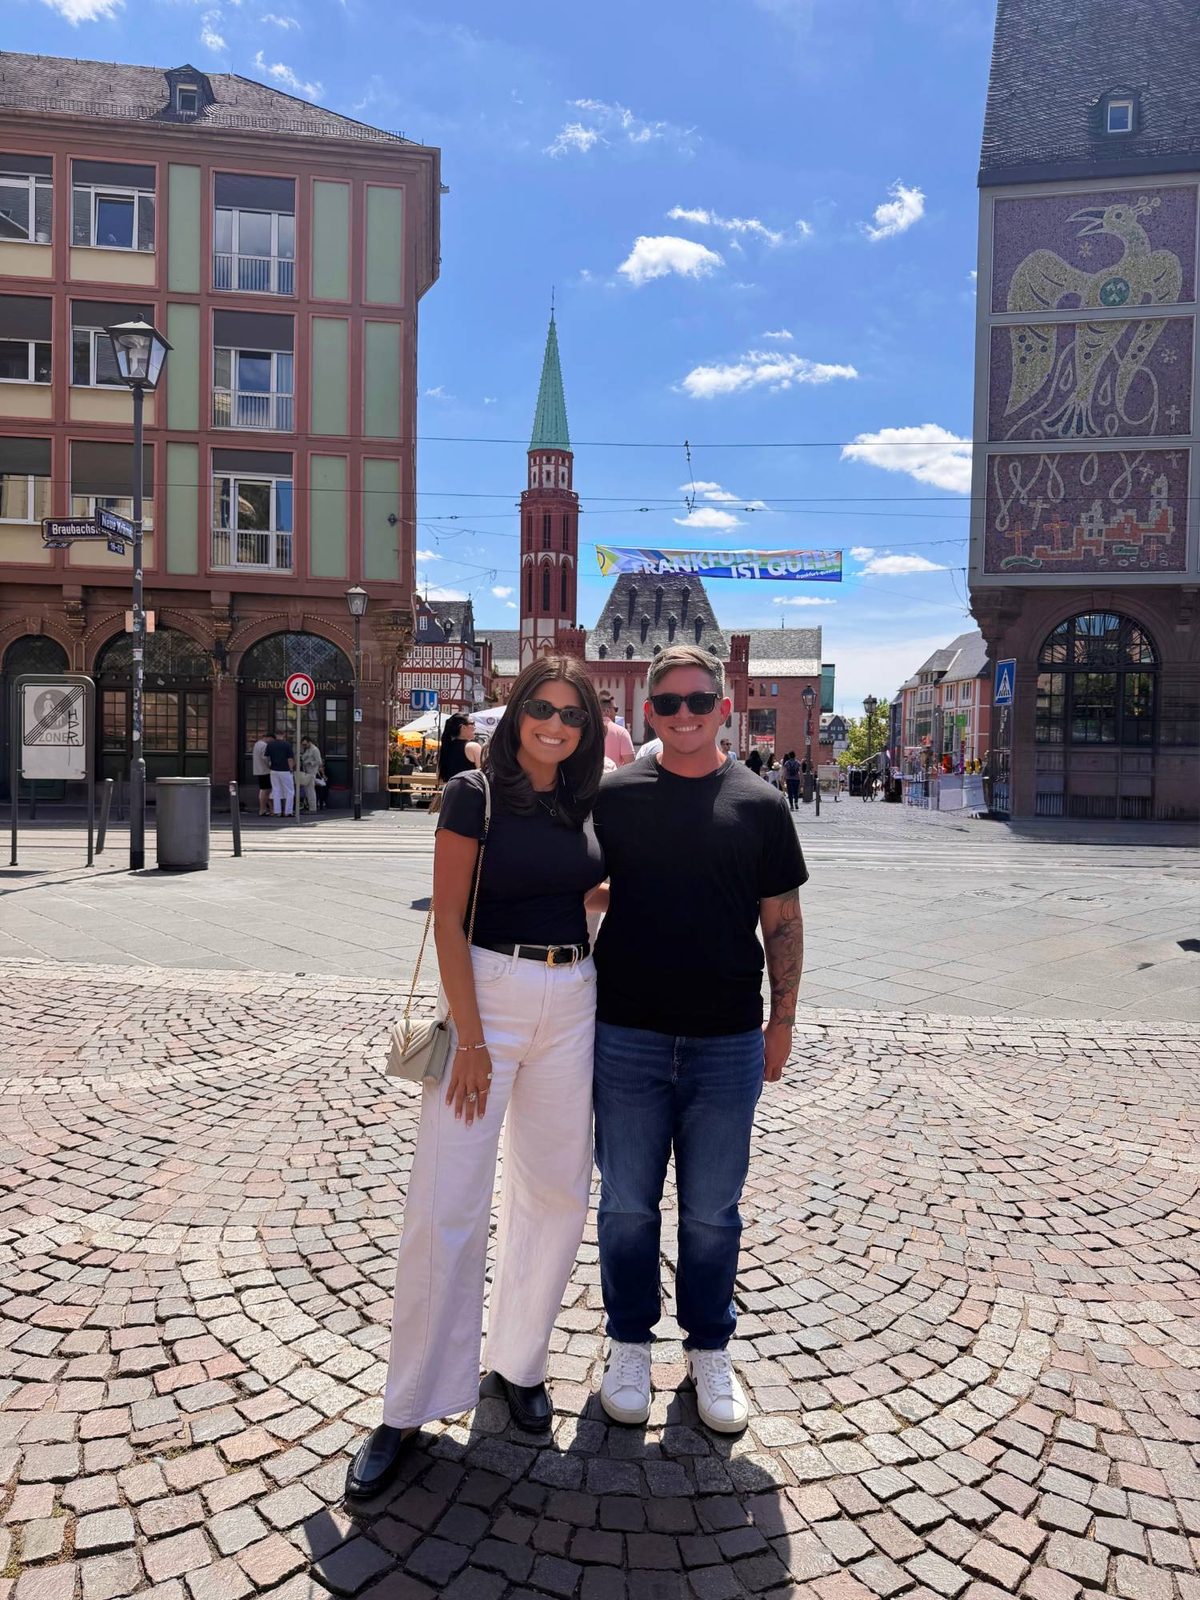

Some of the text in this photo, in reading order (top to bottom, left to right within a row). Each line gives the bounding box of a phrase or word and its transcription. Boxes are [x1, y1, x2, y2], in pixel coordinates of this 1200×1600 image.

[632, 551, 761, 575] FRANKFURT
[731, 562, 761, 579] IST
[292, 682, 309, 697] 40
[39, 732, 69, 743] ZONE
